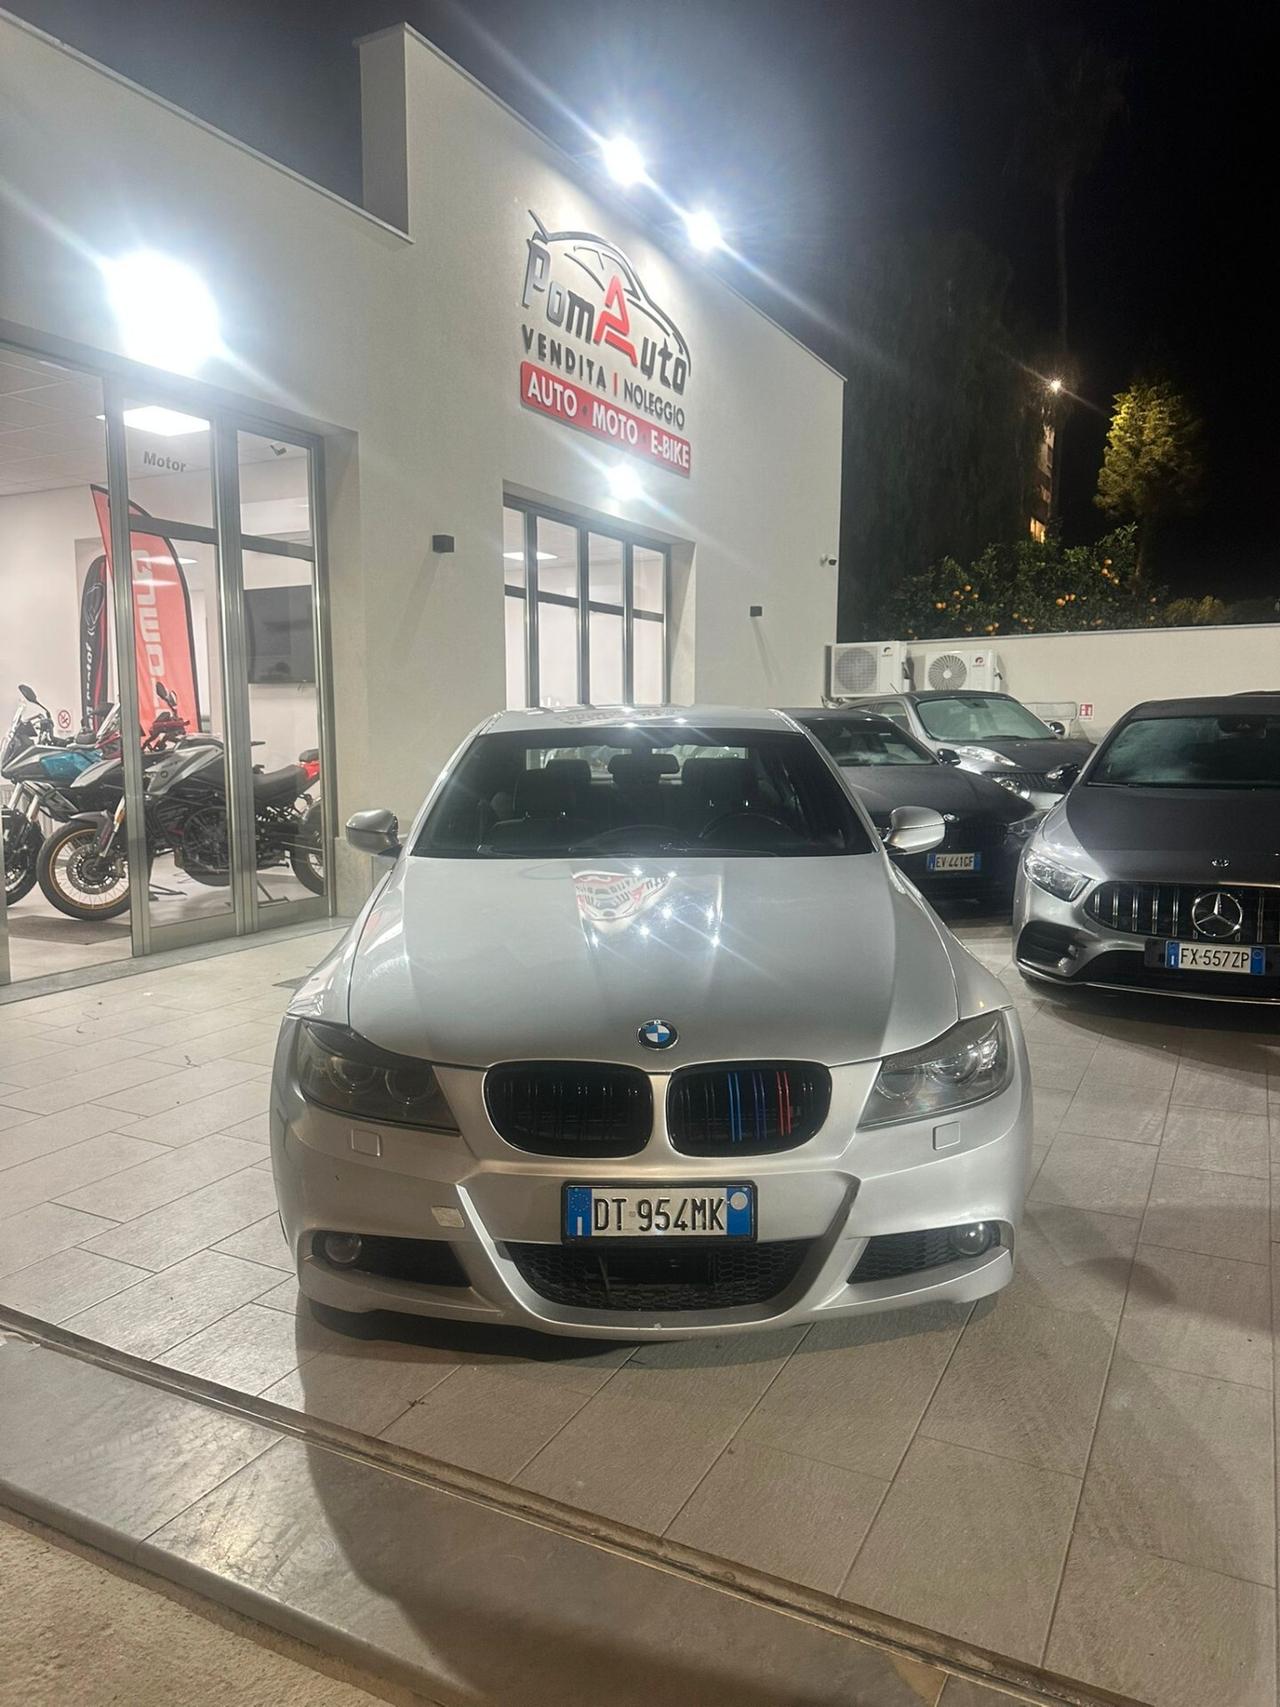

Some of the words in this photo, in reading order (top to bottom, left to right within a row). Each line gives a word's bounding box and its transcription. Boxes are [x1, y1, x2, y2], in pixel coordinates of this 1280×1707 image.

[522, 324, 606, 392] VENDITA
[624, 378, 685, 431] NOLEGGIO
[527, 371, 578, 417] AUTO
[592, 401, 638, 445] MOTO
[651, 429, 689, 469] E-BIKE
[144, 451, 186, 472] Motor
[1180, 948, 1199, 965] FX
[1203, 949, 1250, 968] 557ZP
[594, 1199, 627, 1231] DT
[637, 1198, 725, 1232] 954MK
